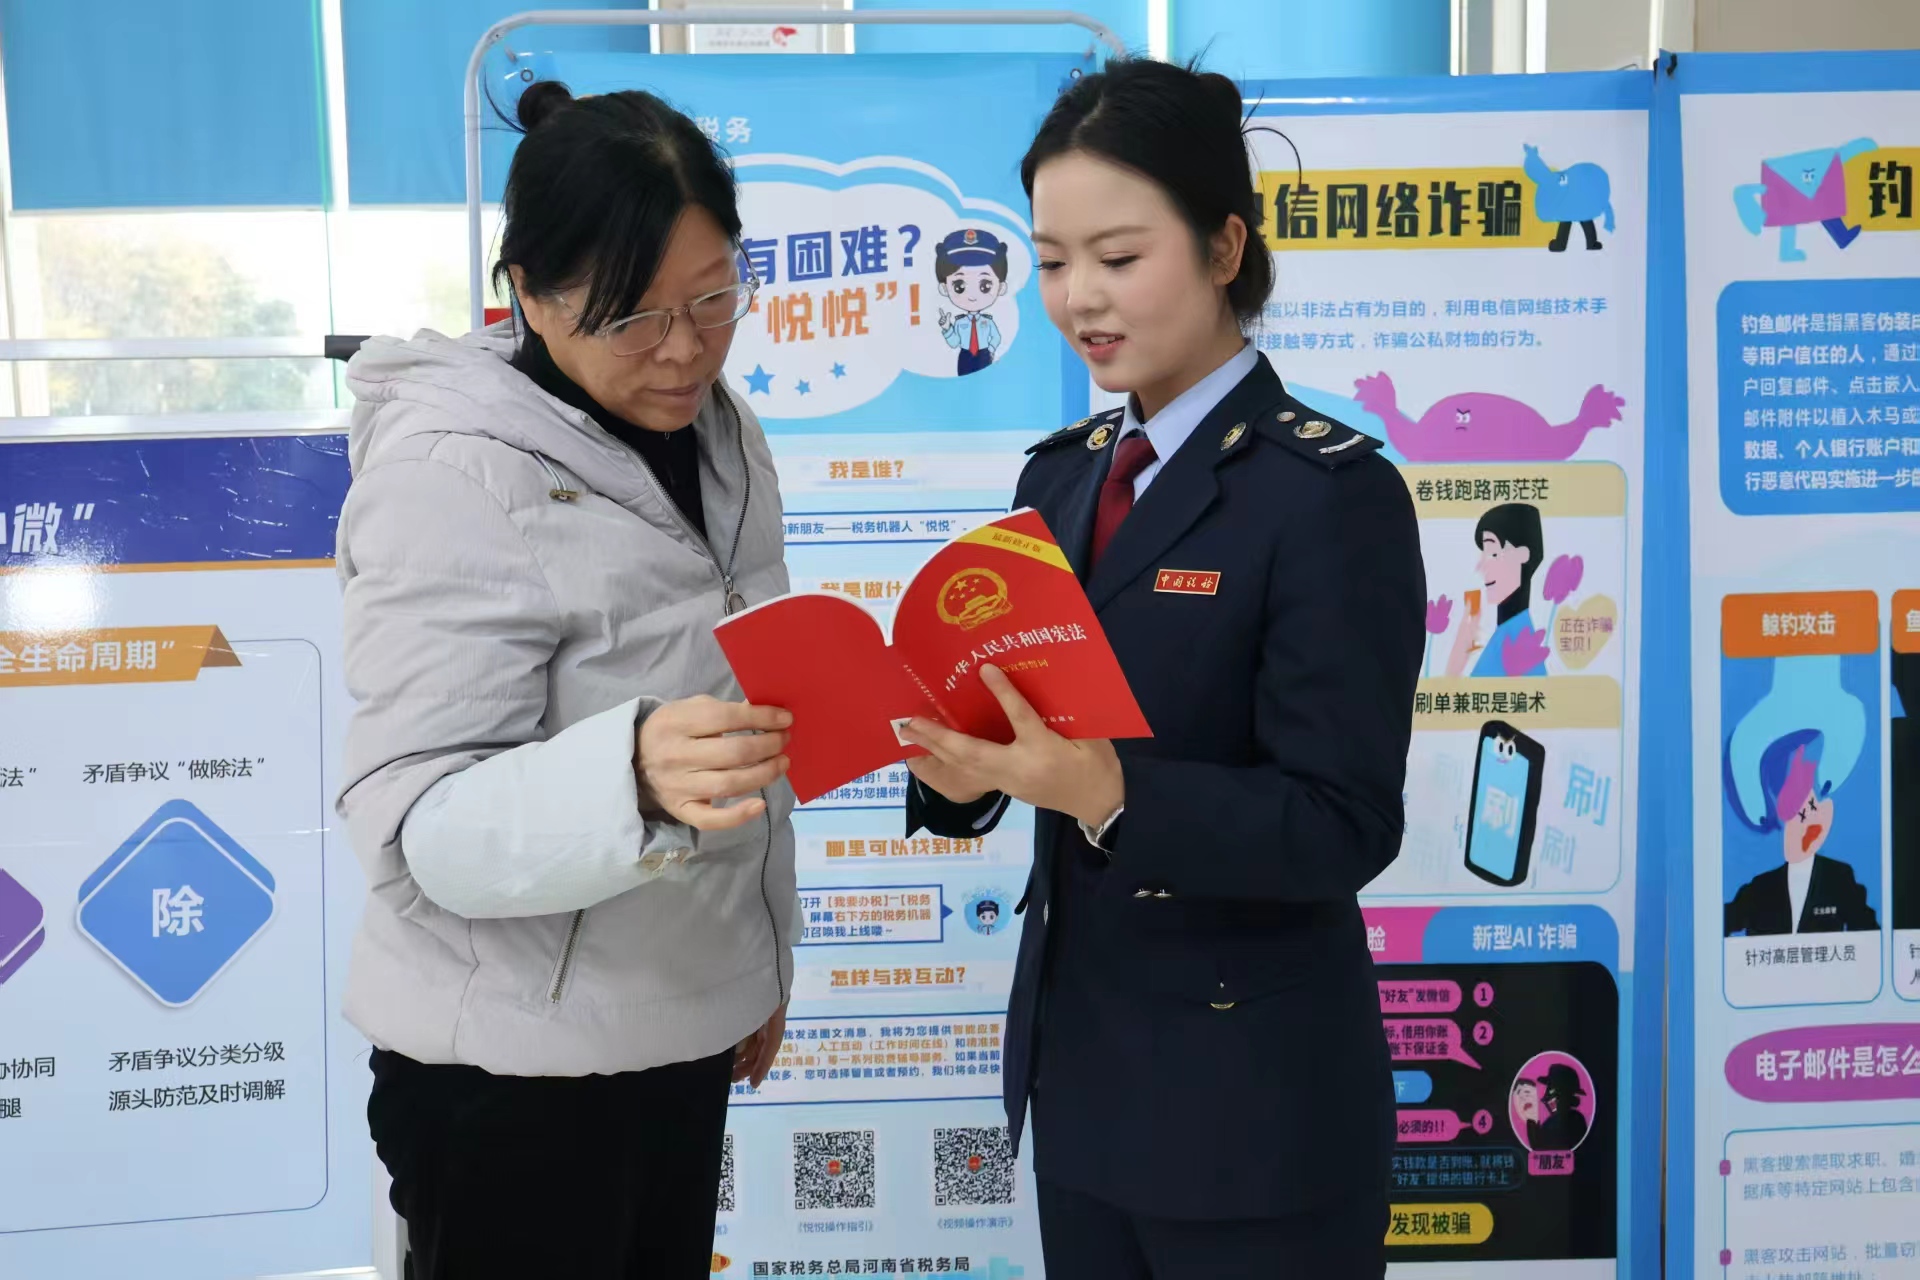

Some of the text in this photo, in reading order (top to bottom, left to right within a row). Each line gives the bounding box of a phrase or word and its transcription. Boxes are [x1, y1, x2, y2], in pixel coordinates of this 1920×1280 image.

[1868, 160, 1913, 219] 钓
[1742, 343, 1920, 366] 等用户信任的人，通过
[1744, 406, 1920, 429] 邮件附件以植入木马或
[1416, 479, 1549, 501] 卷钱跑路两茫茫
[0, 502, 95, 555] 微”
[783, 519, 968, 535] 新朋友——税务机器人“悦悦”。
[1560, 617, 1613, 634] 正在诈骗
[1762, 612, 1836, 637] 鲸钓攻击
[945, 622, 1087, 692] 中华人民共和国宪法
[1415, 692, 1546, 714] 刷单兼职是骗术
[0, 768, 37, 788] 法”
[83, 757, 265, 784] 矛盾争议“做除法”
[1564, 762, 1612, 827] 刷
[151, 885, 205, 938] 除
[1745, 945, 1857, 966] 针对高层管理人员
[1480, 988, 1487, 1001] 1
[1479, 1026, 1487, 1040] 2
[108, 1042, 285, 1073] 矛盾争议分类分级
[108, 1079, 286, 1111] 源头防范及时调解
[1478, 1115, 1486, 1128] 4
[1743, 1151, 1920, 1174] 黑客搜索爬取求职、婚
[1744, 1176, 1920, 1200] 据库等特定网站上包含
[1392, 1212, 1471, 1235] 发现被骗
[1744, 1243, 1920, 1265] 黑客攻击网站，批量窃
[752, 1256, 970, 1277] 国家税务总局河南省税务局
